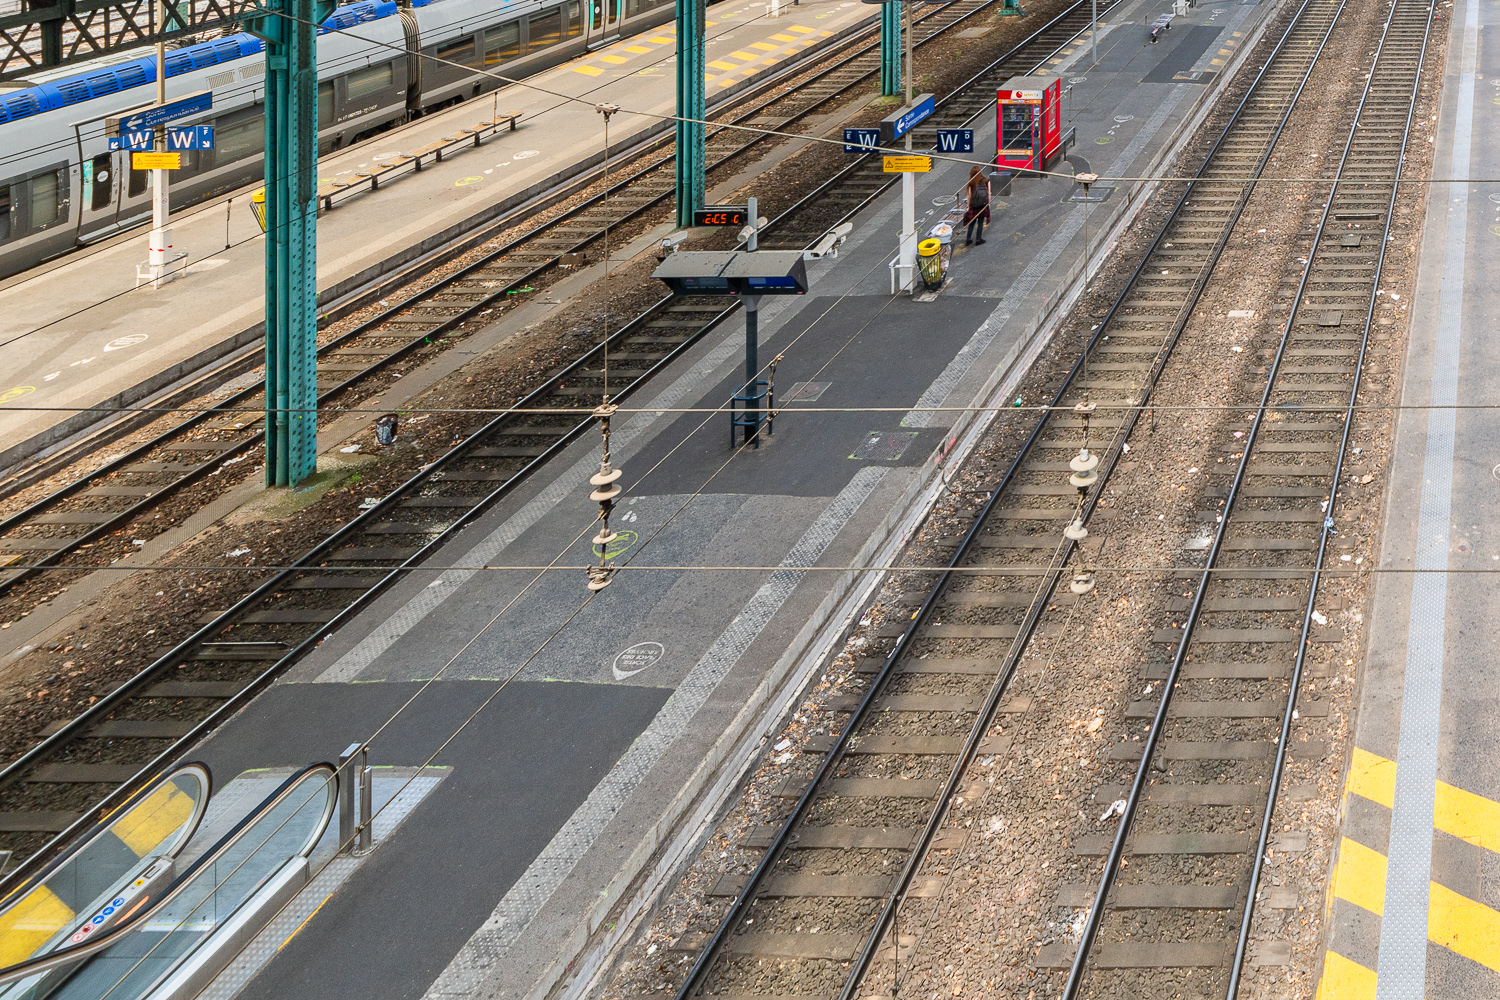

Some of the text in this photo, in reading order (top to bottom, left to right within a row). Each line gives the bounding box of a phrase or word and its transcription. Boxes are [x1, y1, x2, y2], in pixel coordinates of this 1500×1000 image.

[128, 131, 150, 149] W
[171, 131, 194, 149] W
[859, 134, 877, 151] W
[940, 134, 958, 151] W
